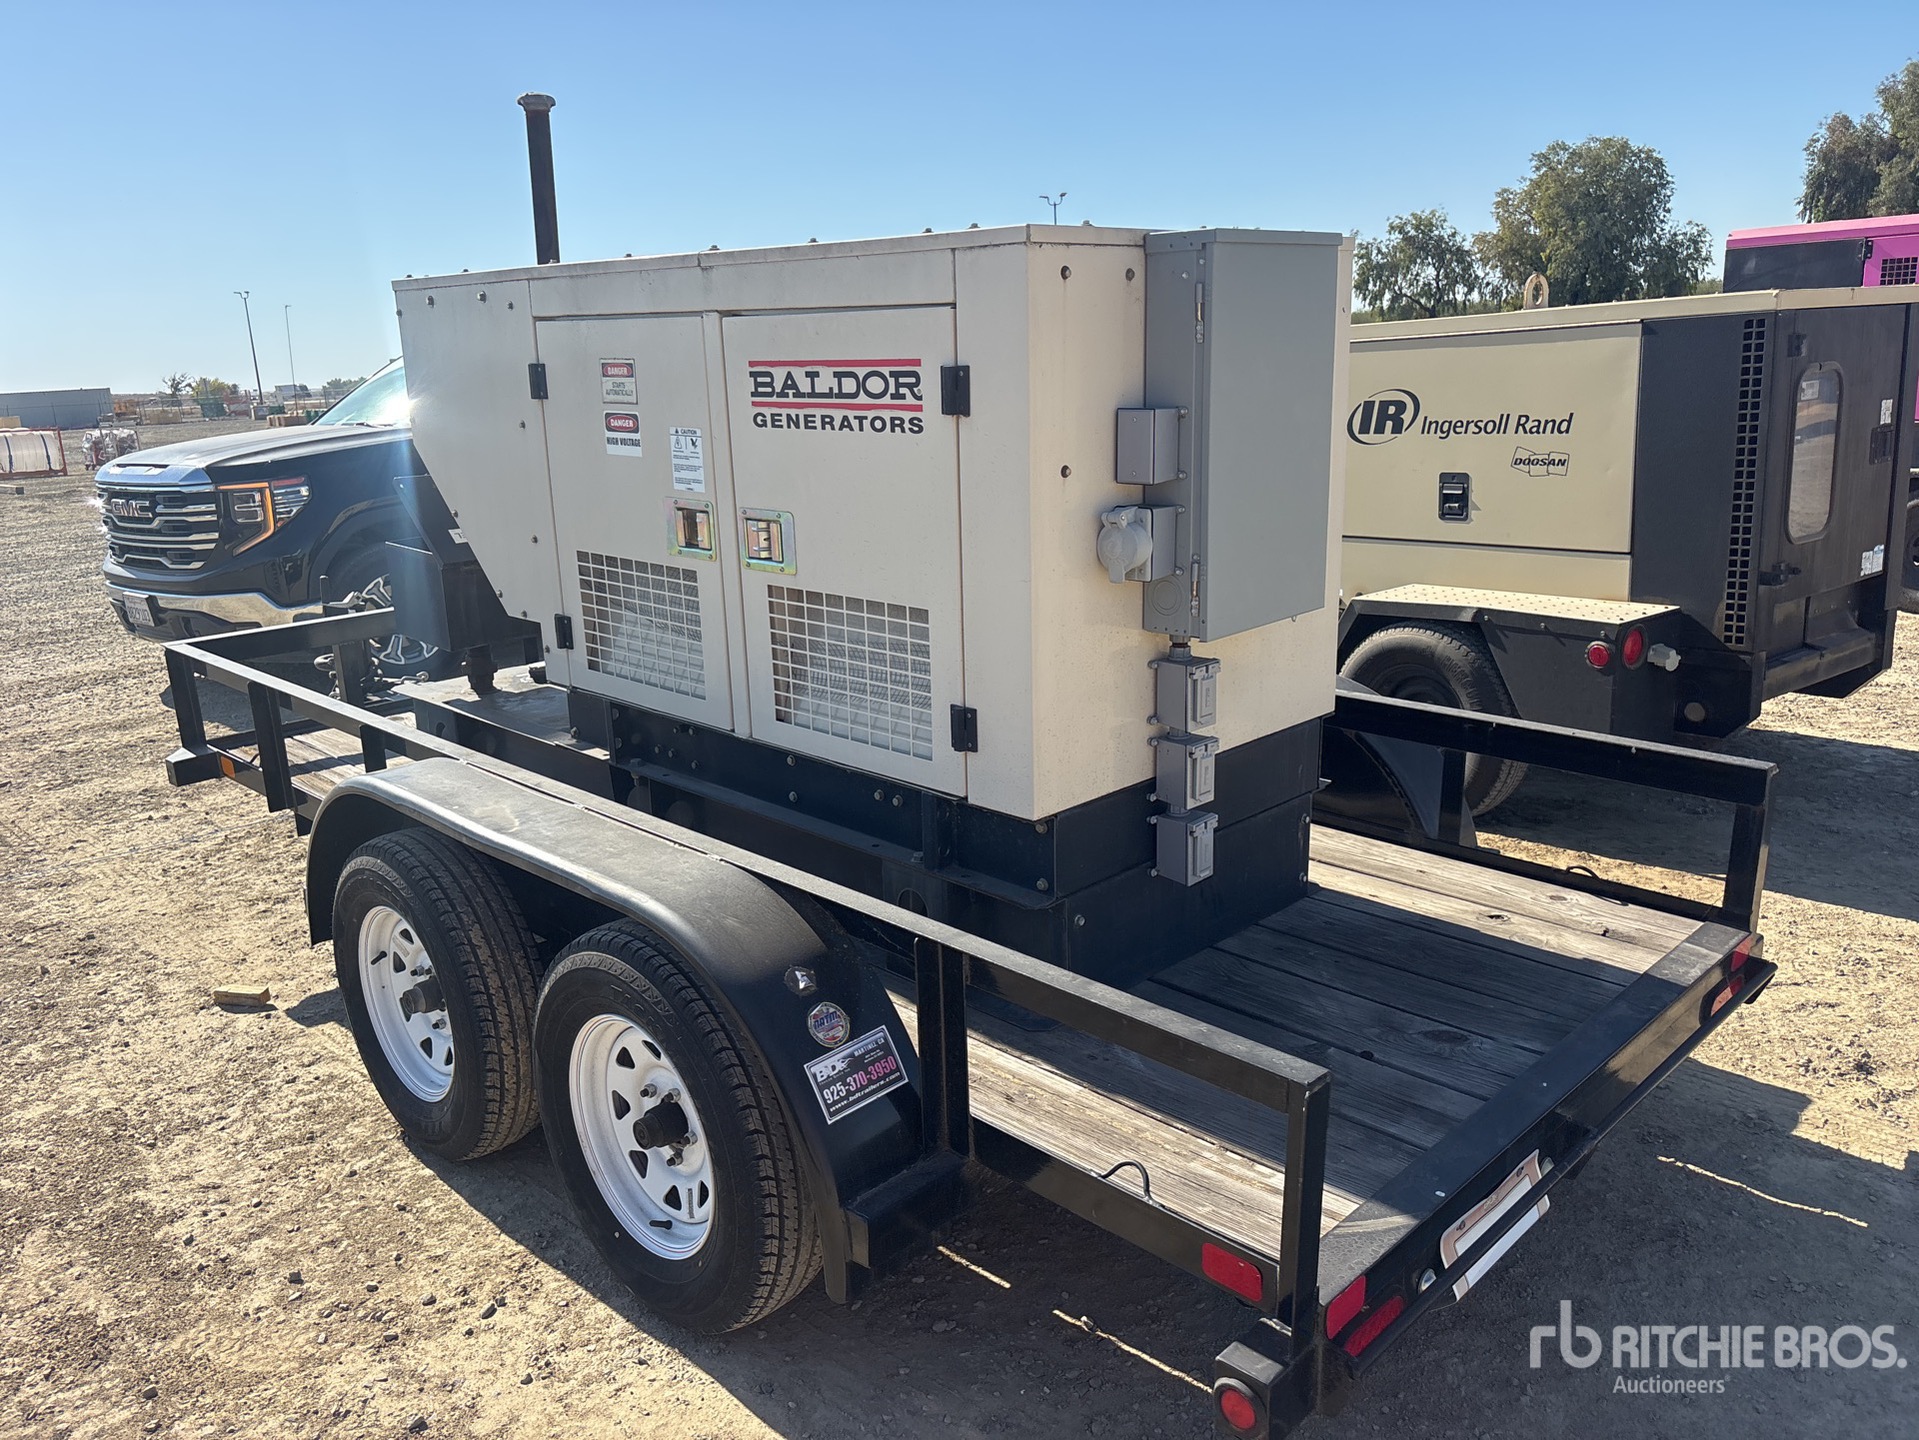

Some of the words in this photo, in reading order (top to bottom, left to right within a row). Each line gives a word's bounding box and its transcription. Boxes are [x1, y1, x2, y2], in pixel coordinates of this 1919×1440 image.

[608, 366, 627, 375] DANGER
[749, 370, 923, 401] BALDOR
[610, 418, 634, 428] DANGER
[753, 412, 924, 434] GENERATORS
[1358, 399, 1408, 435] IR
[1421, 414, 1510, 439] Ingersoll
[1514, 413, 1575, 435] Rand
[606, 436, 619, 446] HIGH
[619, 437, 641, 448] VOLTAGE
[1513, 456, 1567, 468] DOOSAN
[111, 499, 153, 518] GMC
[823, 1055, 897, 1104] 925-370-3950
